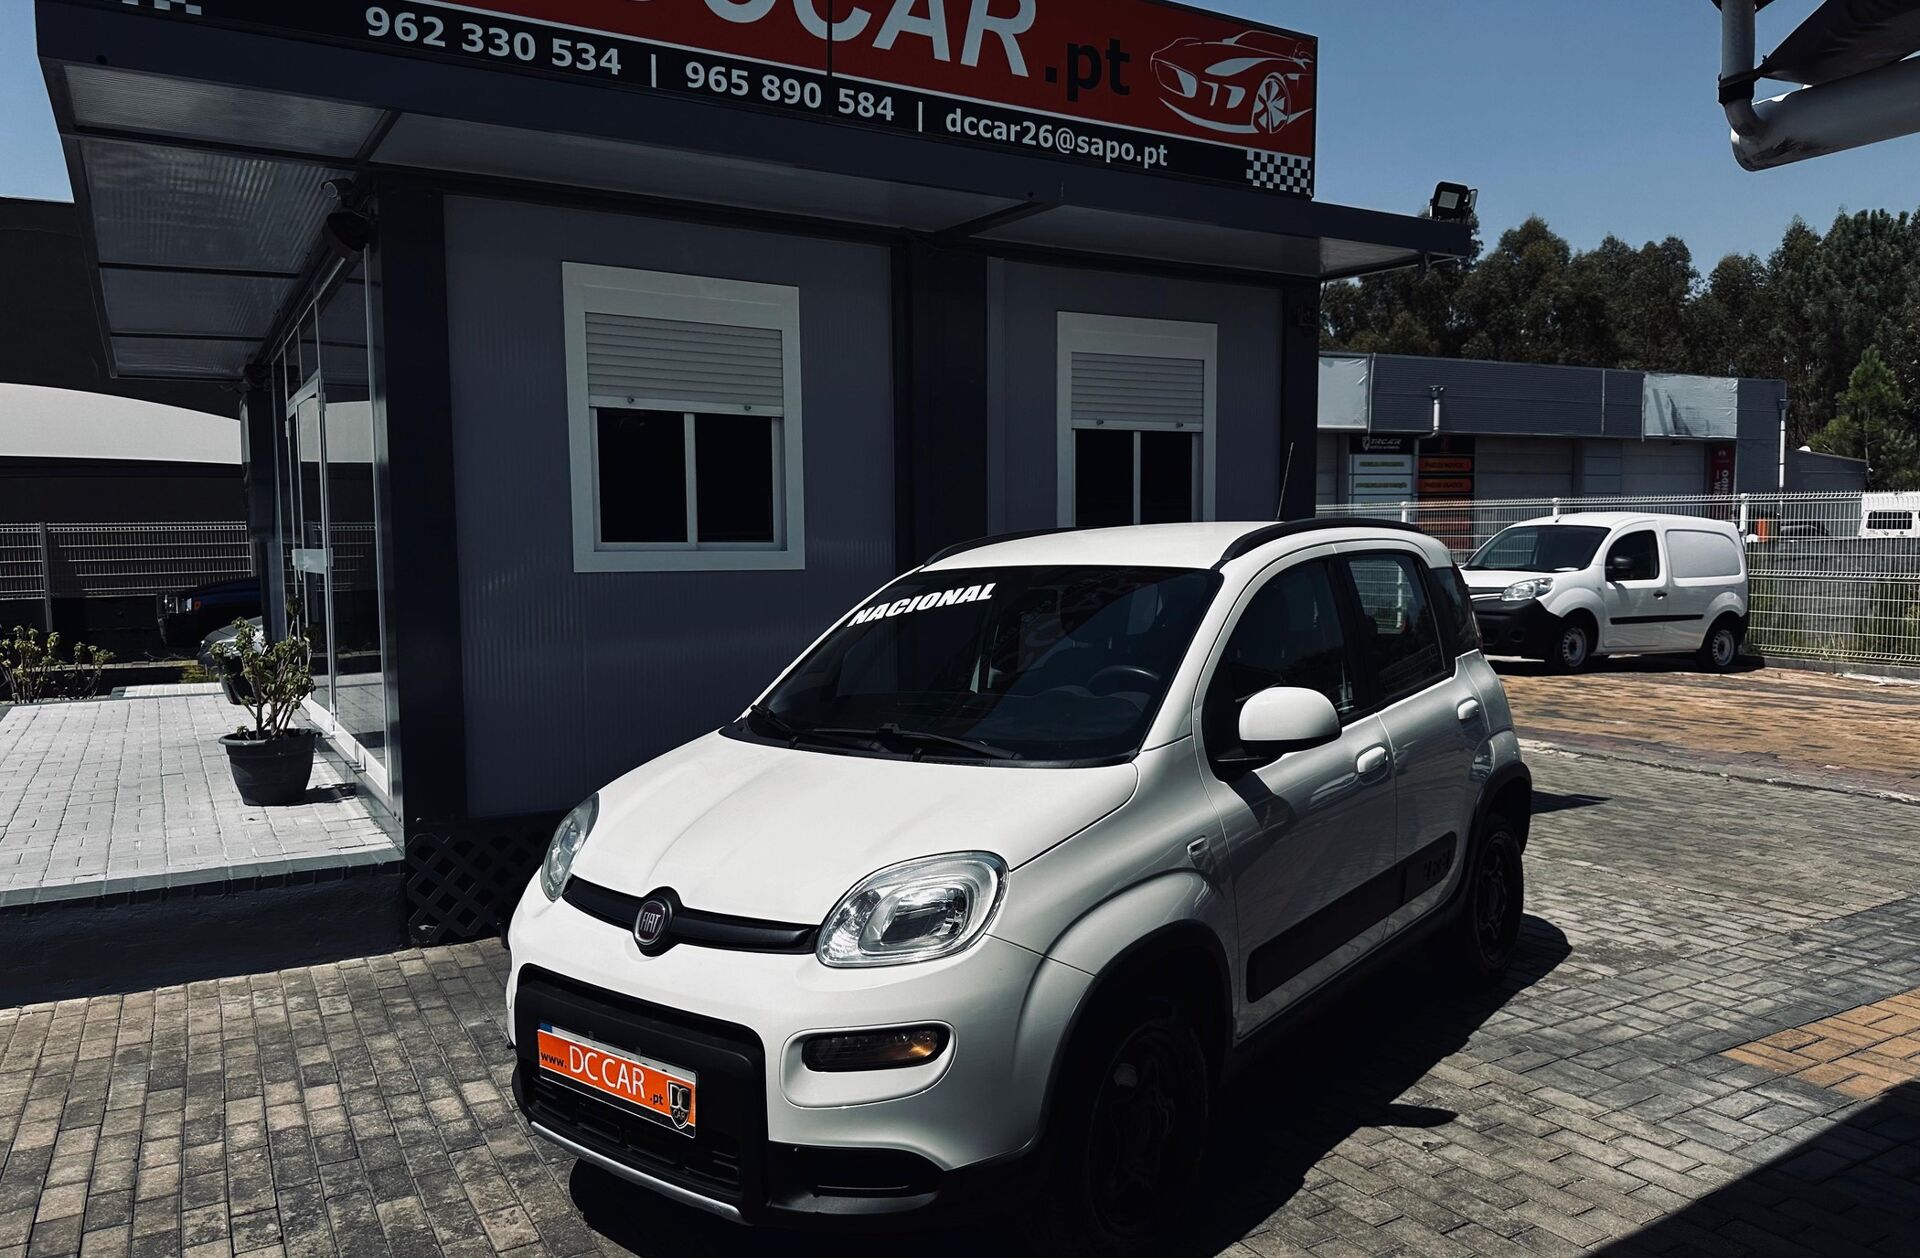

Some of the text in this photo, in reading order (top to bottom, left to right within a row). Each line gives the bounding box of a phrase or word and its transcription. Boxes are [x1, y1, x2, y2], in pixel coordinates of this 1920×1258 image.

[633, 0, 1130, 102] CAR.pt
[365, 6, 1168, 169] 962 330 534 965 890 584 dccar26@sapo.pt
[846, 582, 997, 628] NACIONAL
[640, 912, 661, 933] FIAT
[540, 1045, 664, 1106] www. DC CAR .pt
[672, 1108, 687, 1122] CAR
